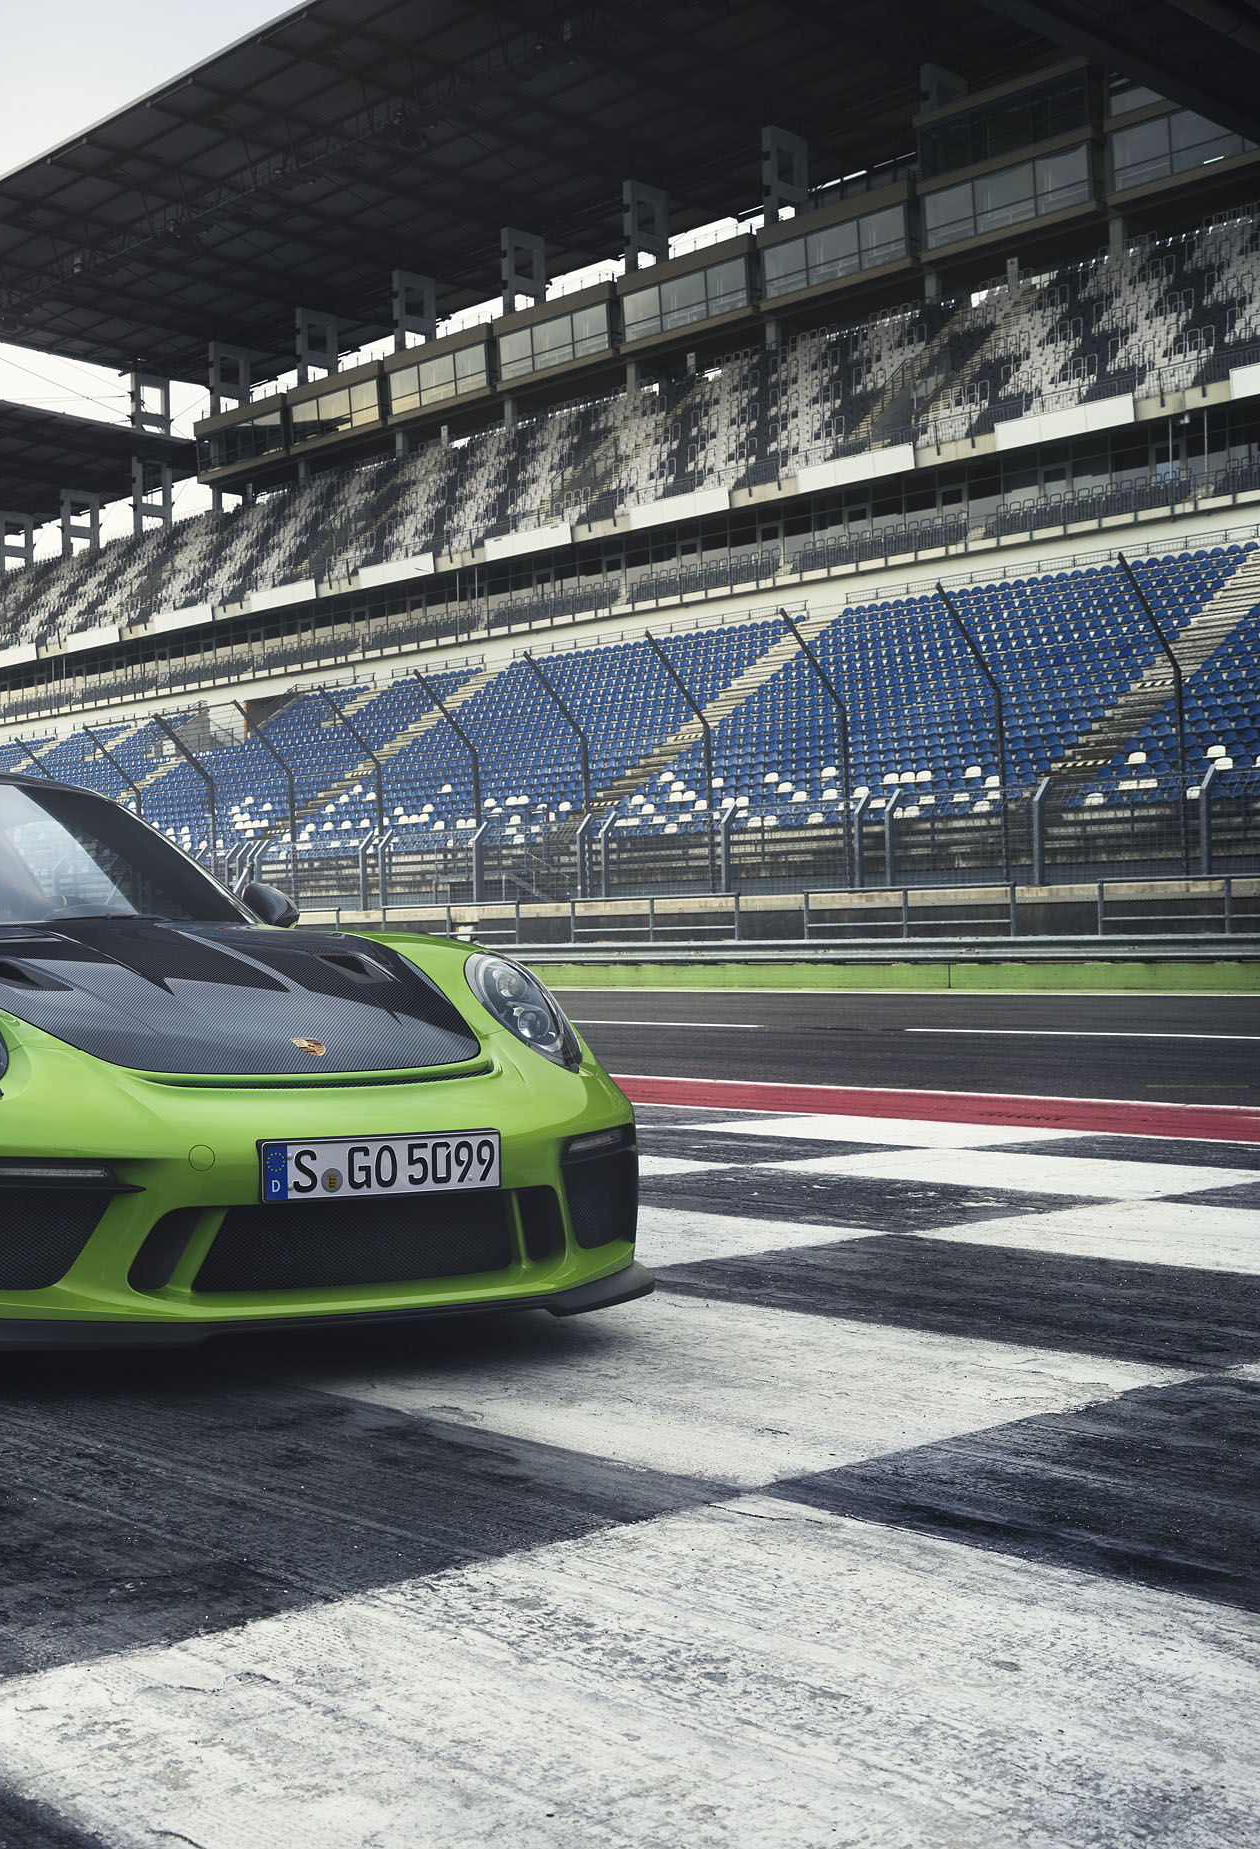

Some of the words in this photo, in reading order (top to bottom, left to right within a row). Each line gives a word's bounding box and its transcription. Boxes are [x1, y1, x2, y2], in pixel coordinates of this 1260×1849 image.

[293, 1149, 318, 1194] S
[347, 1144, 398, 1190] GO
[407, 1139, 495, 1185] 5099
[271, 1180, 281, 1193] D
